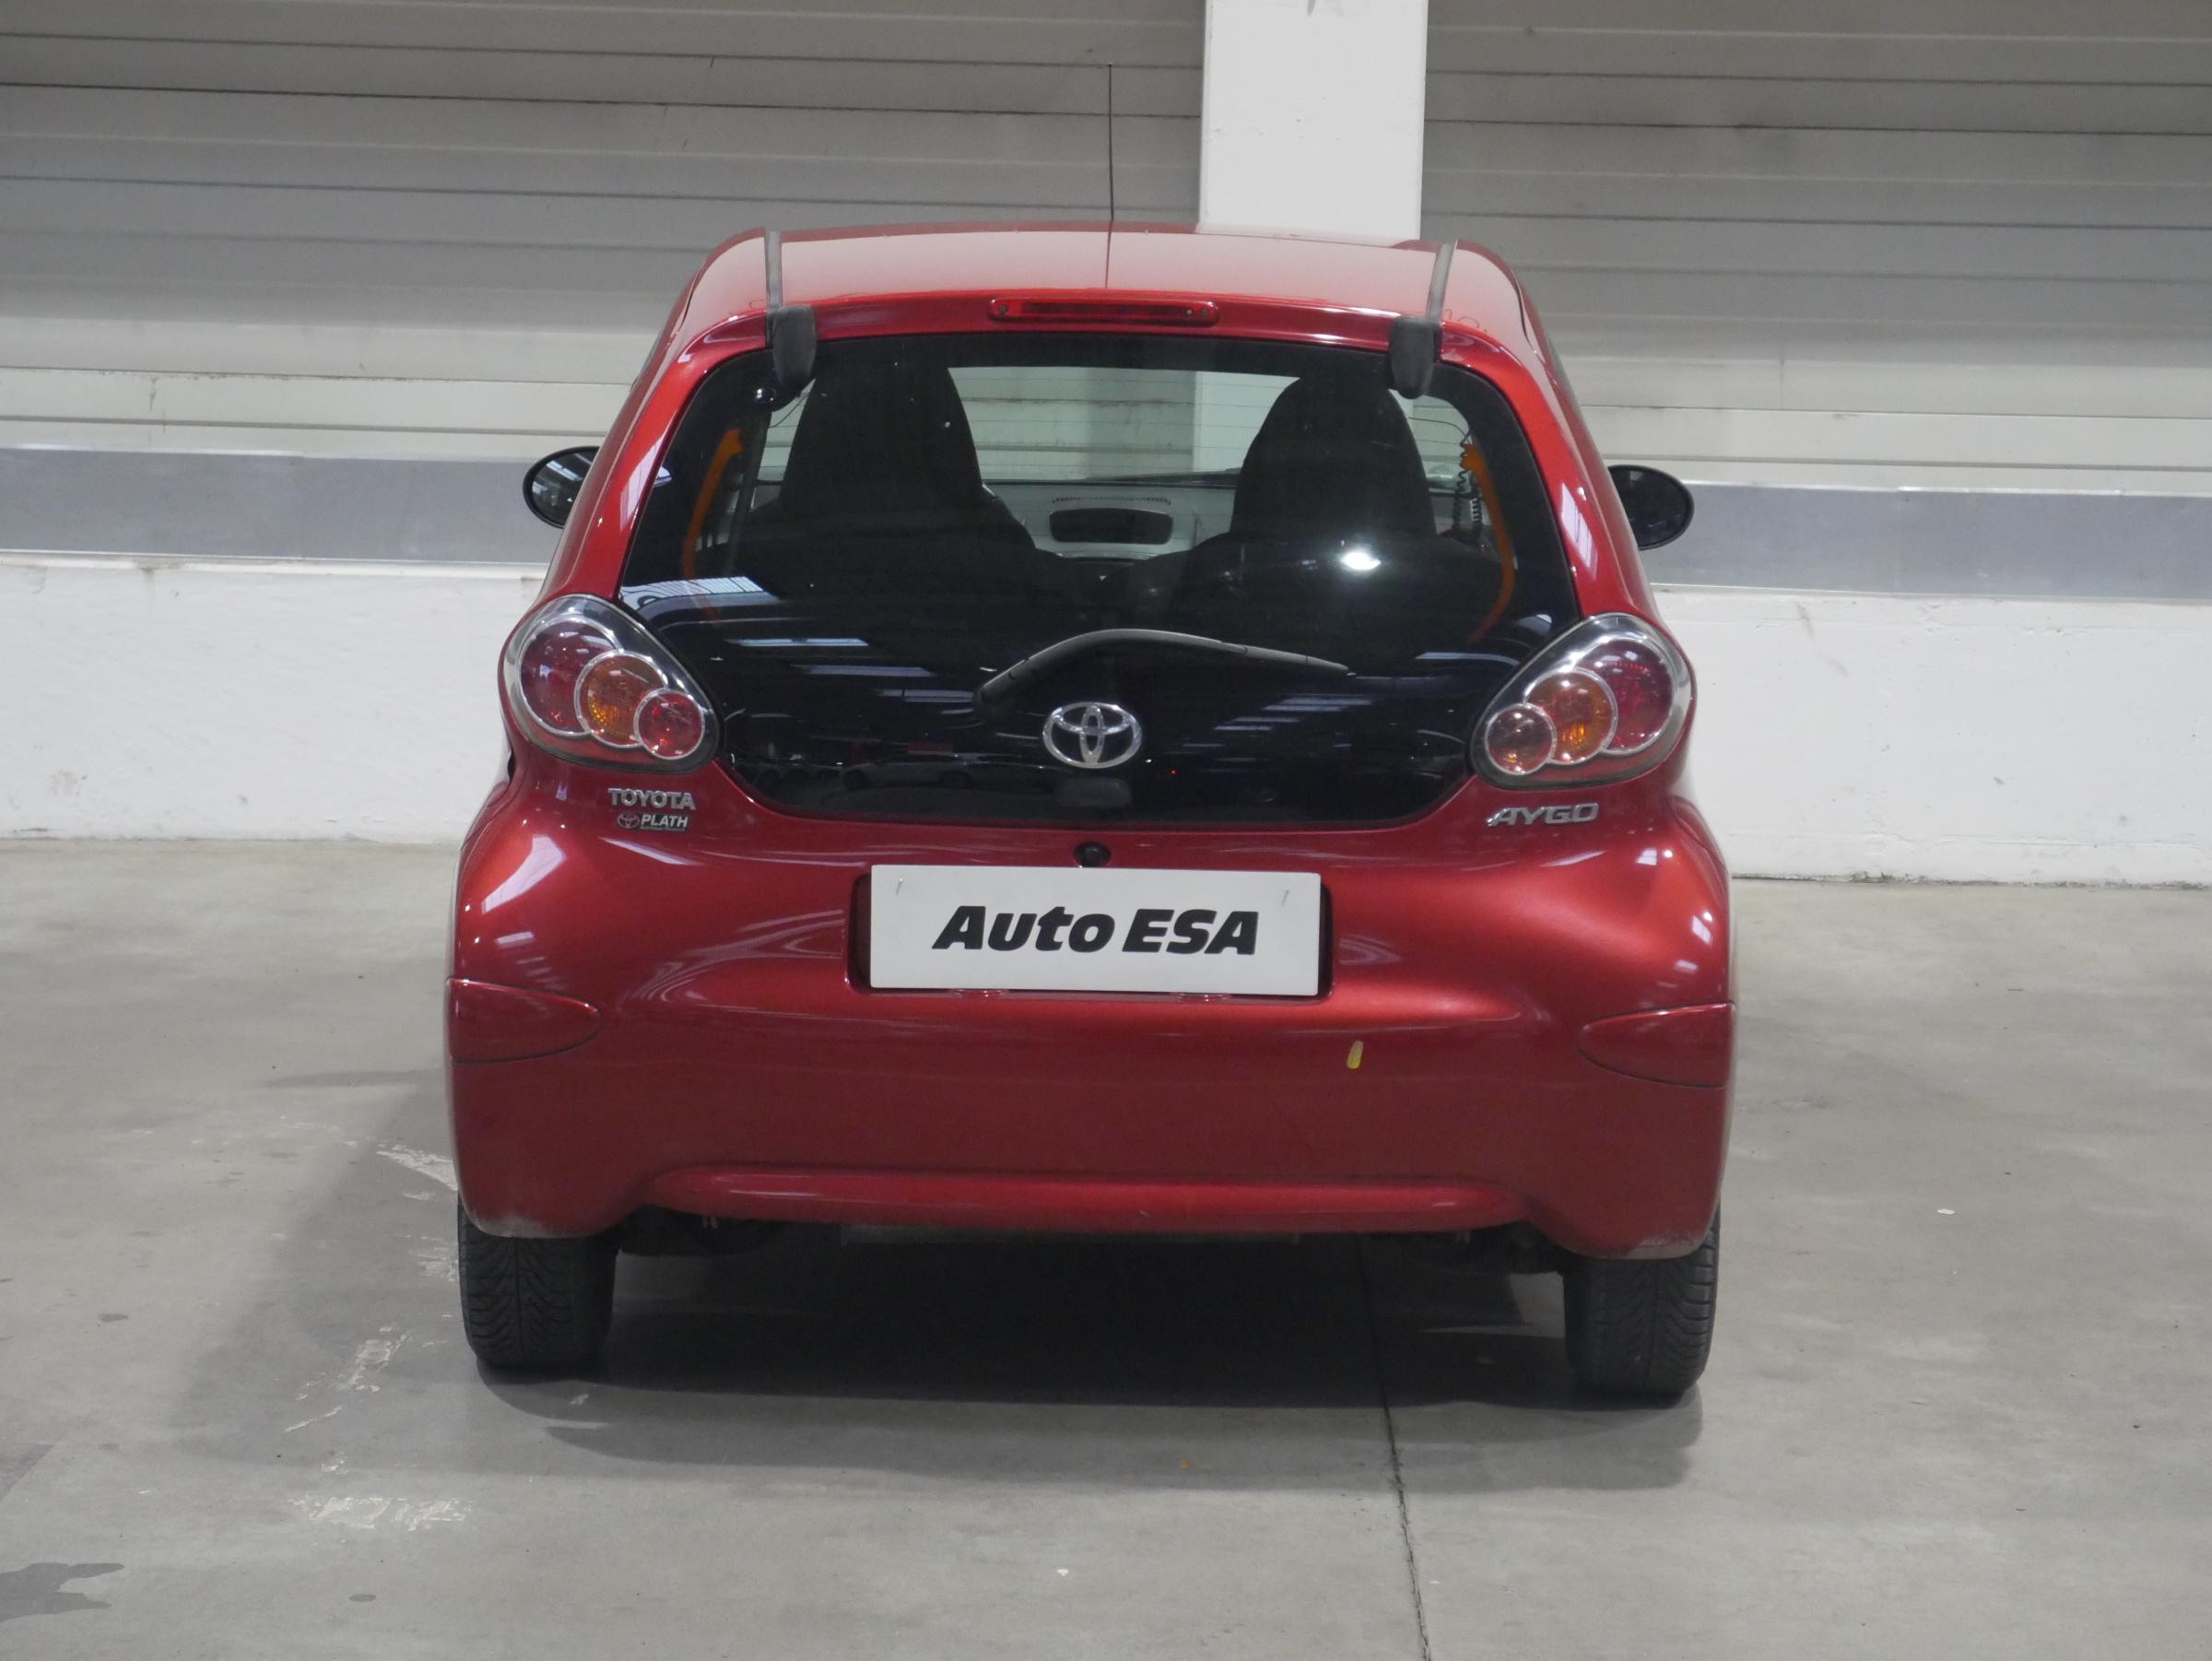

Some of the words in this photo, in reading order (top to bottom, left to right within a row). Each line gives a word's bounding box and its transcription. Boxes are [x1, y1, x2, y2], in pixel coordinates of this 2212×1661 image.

[607, 788, 696, 810] TOYOTA
[641, 814, 688, 828] PLATH
[1486, 803, 1599, 826] AYGO
[932, 905, 1115, 952] Auto
[1122, 908, 1259, 956] ESA
